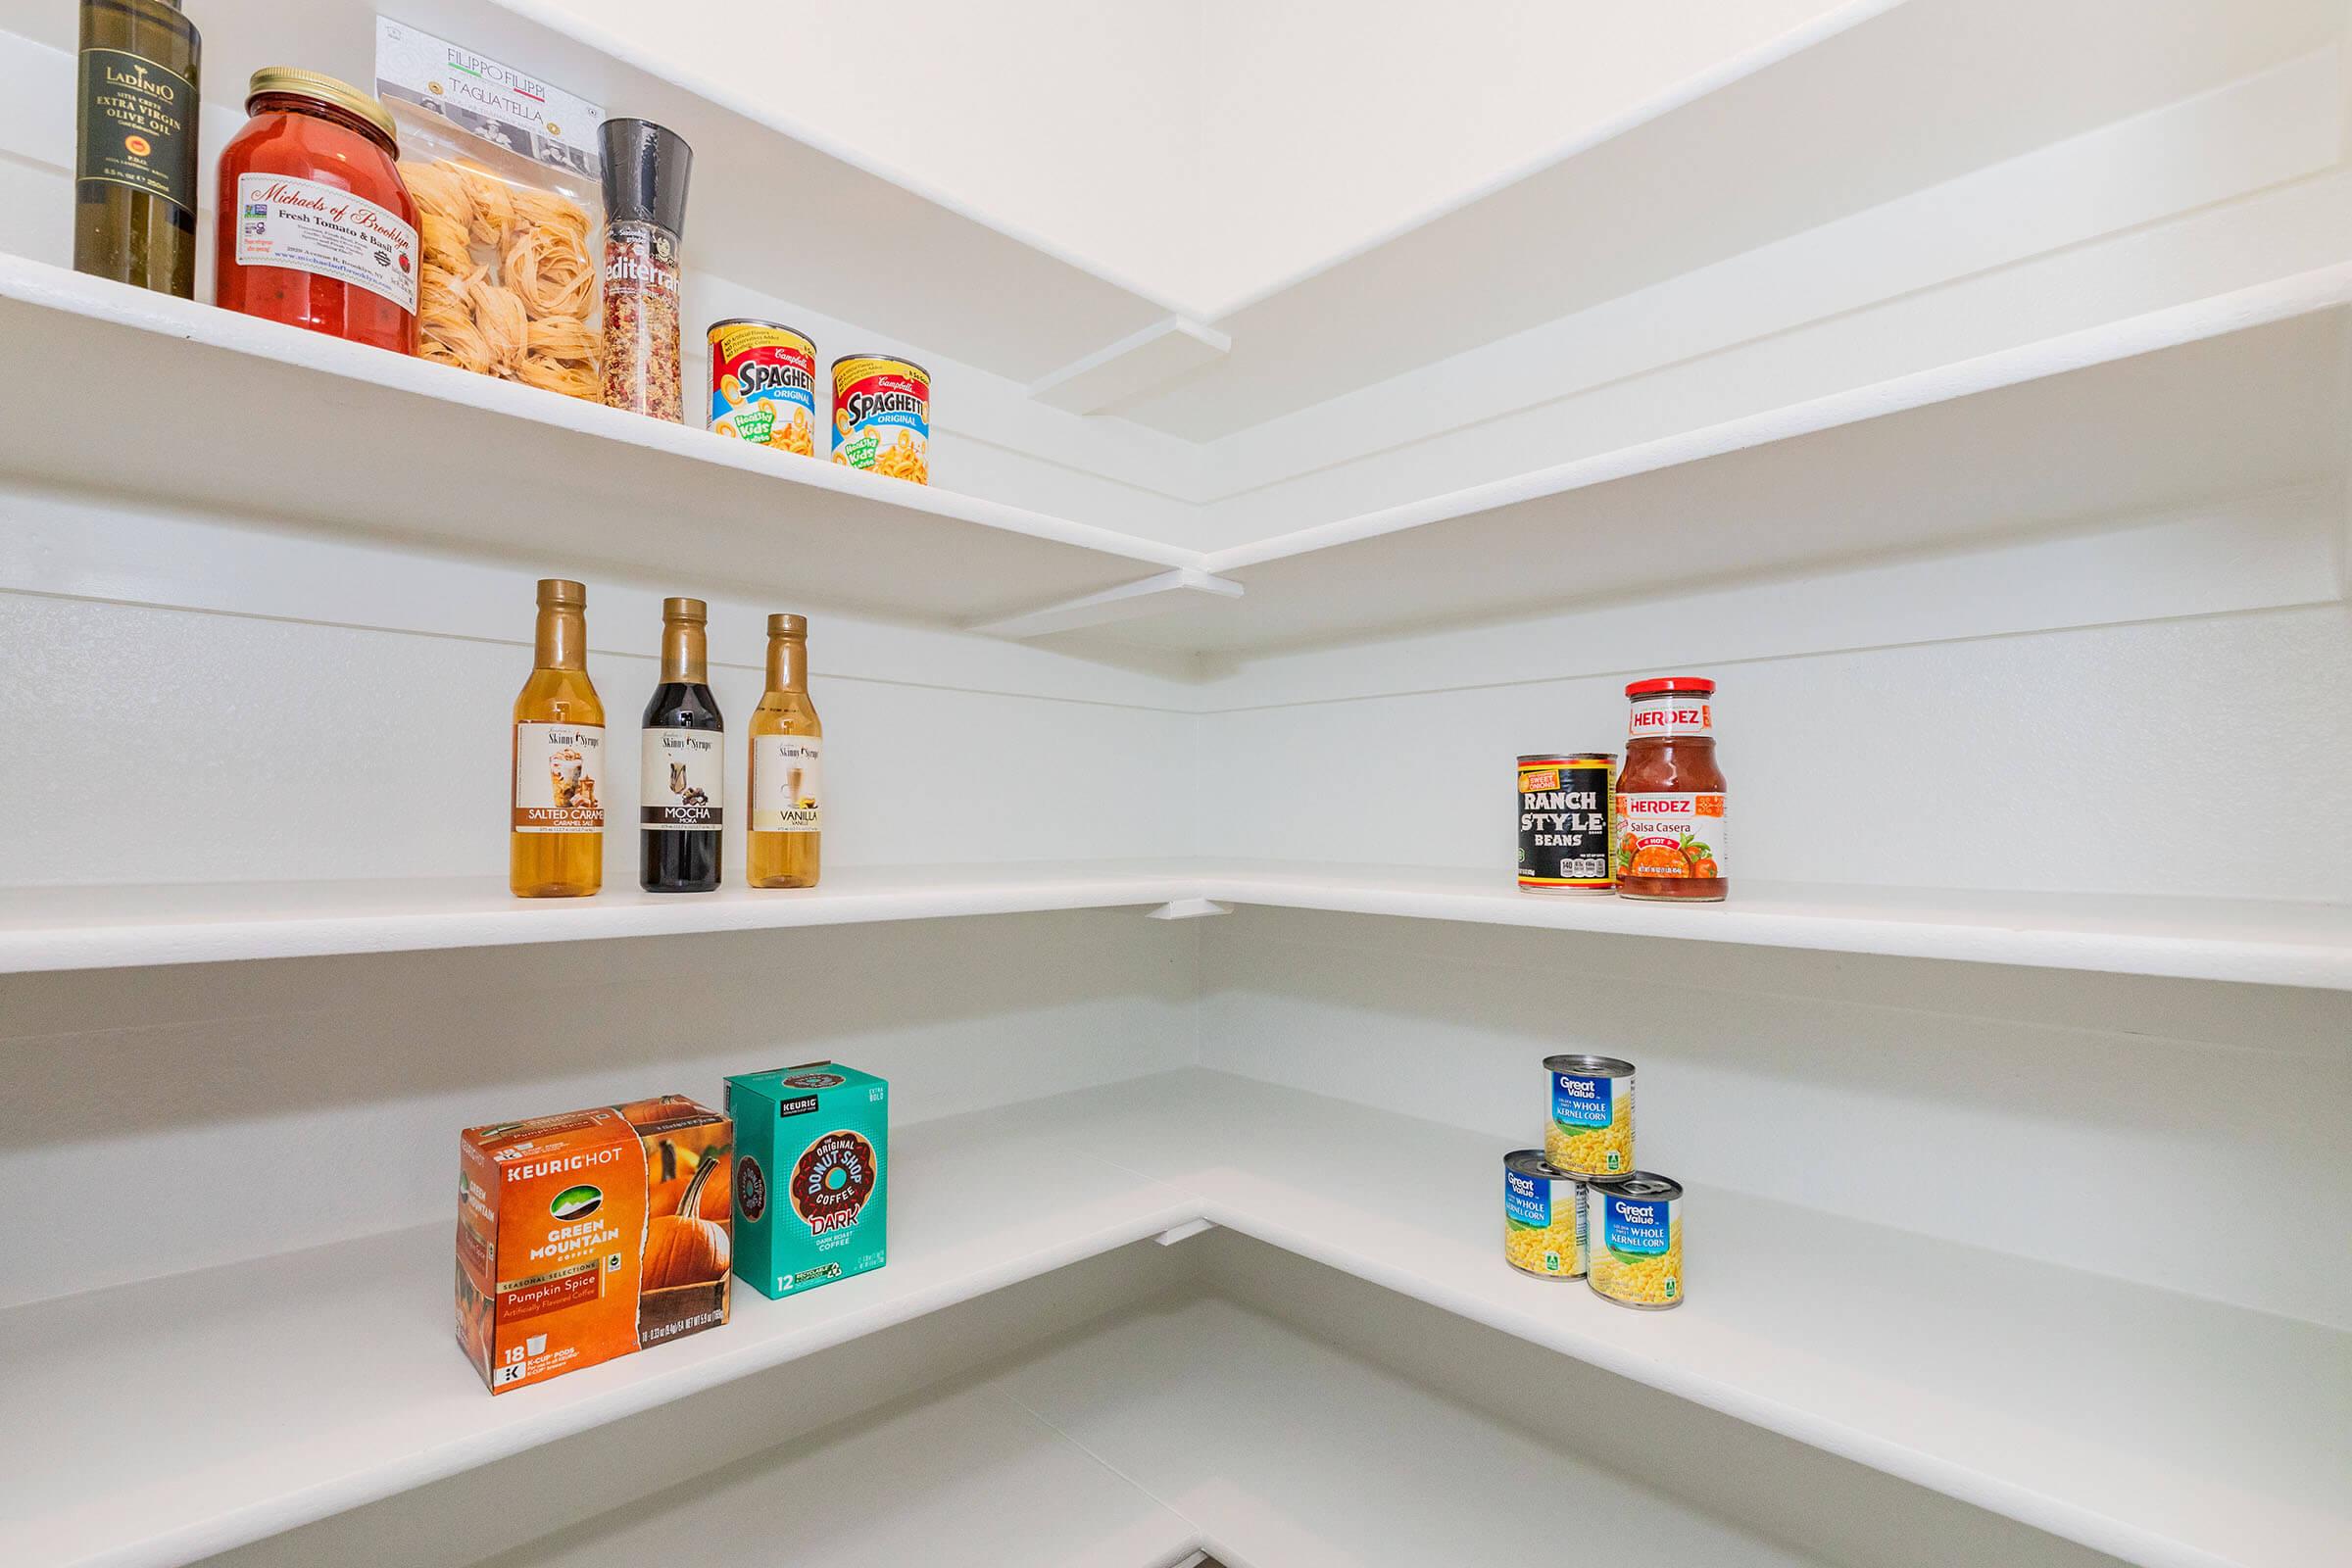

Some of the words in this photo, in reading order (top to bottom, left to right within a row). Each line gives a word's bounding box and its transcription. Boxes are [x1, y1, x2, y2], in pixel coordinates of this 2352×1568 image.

[447, 48, 504, 80] FILIPPO
[505, 72, 545, 99] FILIPPI
[448, 77, 544, 125] TAGLIATELLA
[97, 96, 135, 111] EXTRA
[139, 105, 180, 130] VIRGIN
[107, 109, 145, 124] OLIVE
[149, 120, 171, 135] OIL
[251, 183, 327, 212] Michaels
[329, 203, 351, 222] of
[350, 208, 410, 250] Brooklyn
[278, 210, 311, 222] Fresh
[314, 216, 357, 236] Tomato
[360, 231, 368, 242] &
[369, 236, 393, 253] Basil
[773, 390, 810, 406] ORIGINAL
[736, 413, 773, 426] Healthy
[877, 415, 916, 426] ORIGINAL
[740, 423, 770, 437] Kids
[850, 448, 875, 464] Kids
[1635, 710, 1699, 727] HERDEZ
[549, 733, 574, 748] Skinny
[580, 735, 600, 749] Syrups
[662, 738, 685, 751] Skinny
[1530, 775, 1553, 784] SWEET
[1524, 792, 1597, 810] RANCH
[1631, 800, 1690, 814] HERDEZ
[528, 808, 569, 820] SALTED
[664, 807, 710, 819] MOCHA
[780, 810, 818, 821] VANILLA
[1521, 812, 1603, 832] STYLE
[1631, 823, 1654, 832] Salsa
[1656, 823, 1691, 833] Casera
[1535, 834, 1583, 846] BEANS
[1560, 1076, 1595, 1092] Great
[1568, 1089, 1595, 1099] Value
[783, 1098, 817, 1111] KEURIG
[1573, 1102, 1606, 1112] WHOLE
[1557, 1107, 1583, 1119] KERNEL
[816, 1140, 855, 1156] ORIGINAL
[508, 1155, 583, 1183] KEURIG
[585, 1147, 623, 1167] HOT
[808, 1150, 839, 1195] DONUT
[841, 1151, 862, 1184] SHOP
[1508, 1172, 1534, 1191] Great
[816, 1186, 855, 1205] COFFEE
[1512, 1185, 1534, 1198] Value
[1516, 1199, 1545, 1212] WHOLE
[1615, 1201, 1654, 1217] Great
[808, 1203, 860, 1237] DARK
[1524, 1209, 1545, 1221] CORN
[1625, 1215, 1654, 1225] Value
[548, 1218, 605, 1244] GREEN
[1631, 1227, 1664, 1238] WHOLE
[530, 1228, 619, 1261] MOUNTAIN
[815, 1237, 833, 1246] DARK
[818, 1239, 850, 1252] COFFEE
[1611, 1234, 1642, 1247] KERNEL
[1642, 1239, 1664, 1248] CORN
[503, 1276, 547, 1291] SEASONAL
[548, 1262, 597, 1280] SELECTIONS
[777, 1275, 794, 1292] 12
[508, 1285, 562, 1305] Pumpkin
[564, 1276, 596, 1293] Spice
[541, 1296, 571, 1308] Flavored
[571, 1289, 596, 1299] Coffee
[505, 1346, 525, 1365] 18
[553, 1347, 576, 1359] PODS
